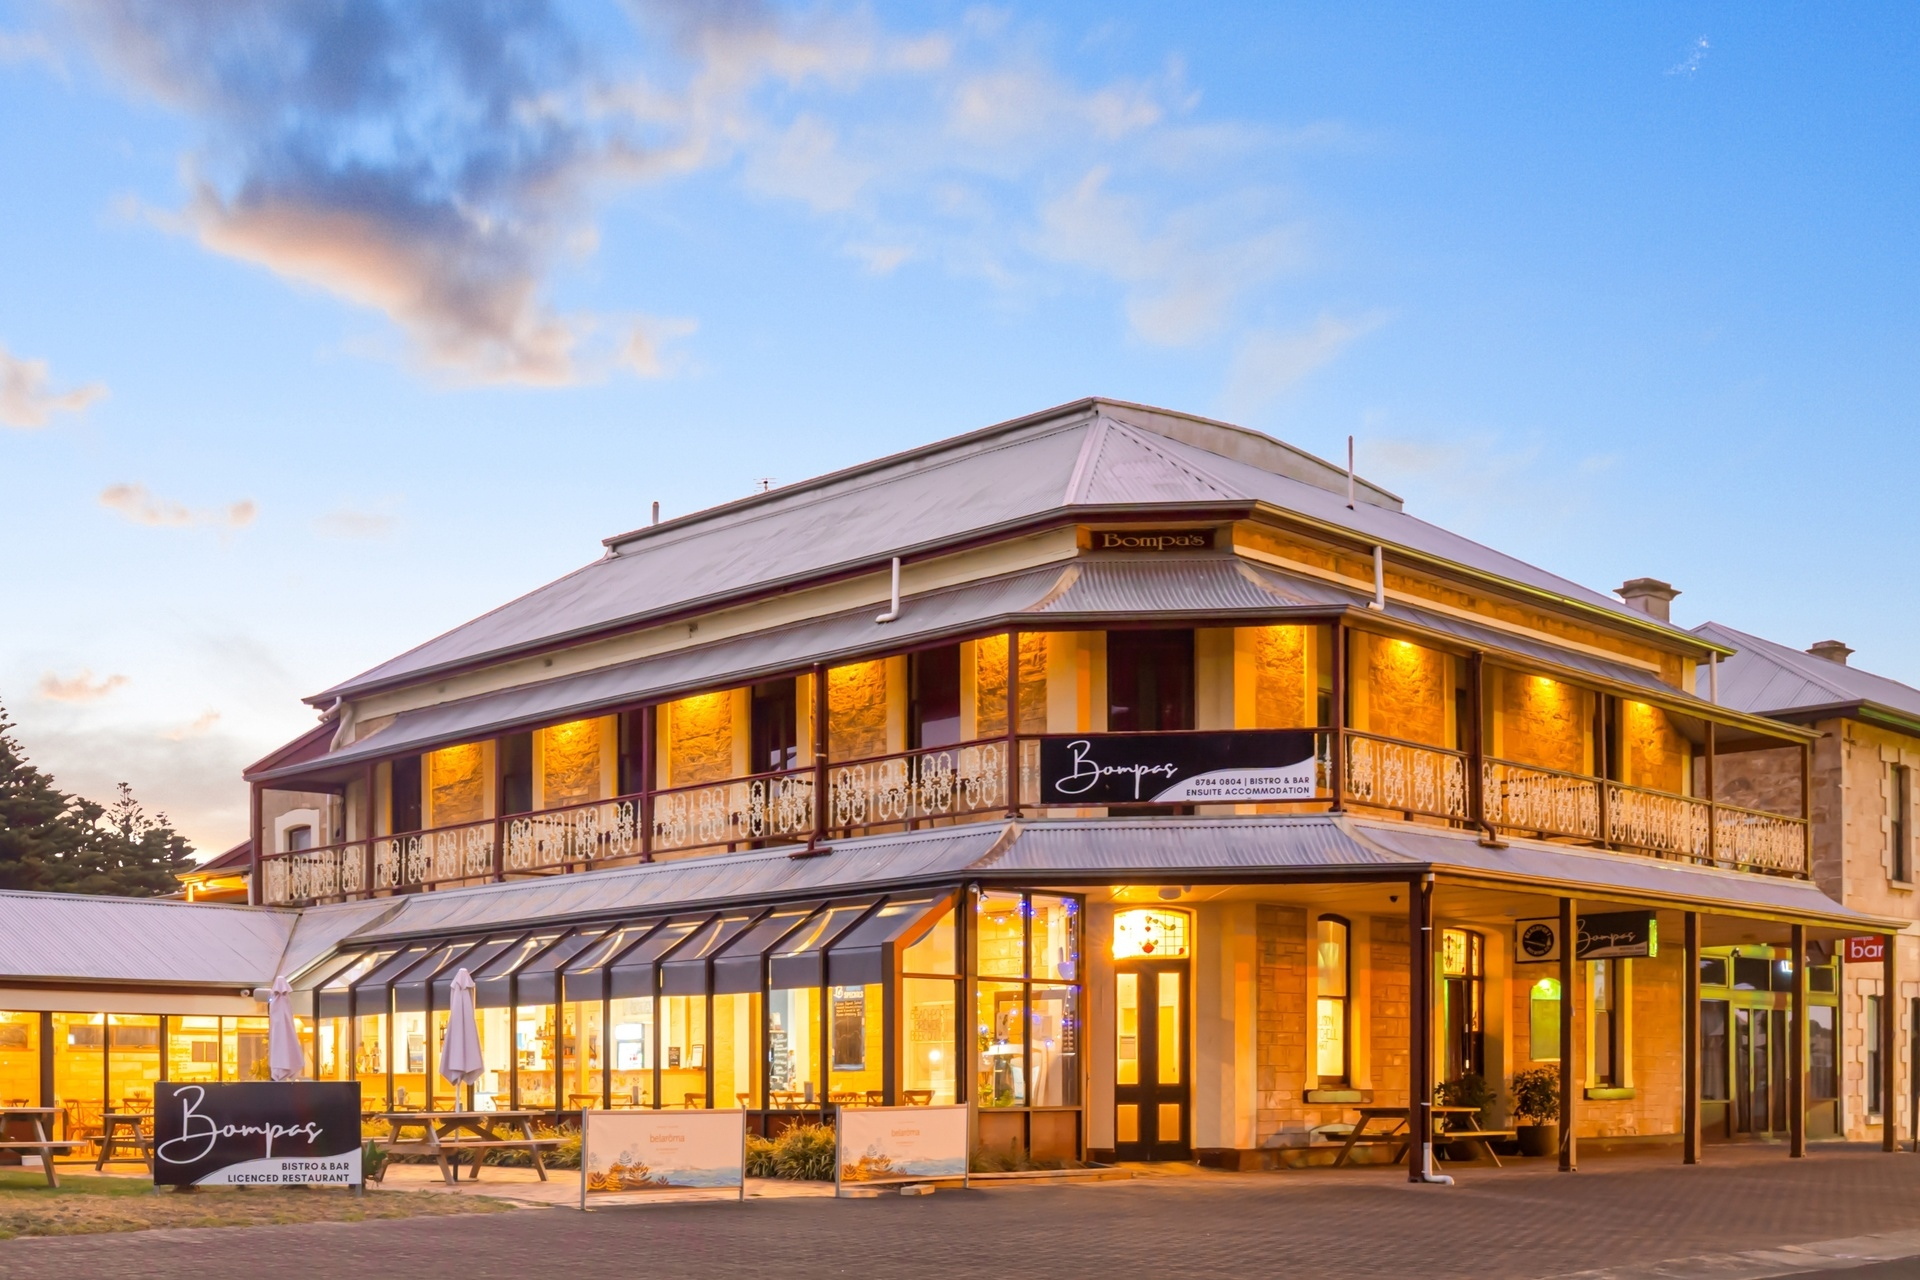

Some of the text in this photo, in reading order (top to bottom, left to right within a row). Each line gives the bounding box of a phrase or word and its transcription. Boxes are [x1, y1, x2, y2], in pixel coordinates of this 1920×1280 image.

[1102, 533, 1205, 550] Bompa's
[1055, 740, 1178, 799] Bompas
[1219, 778, 1242, 786] 0804
[1249, 777, 1281, 785] BISTRO
[1186, 786, 1310, 796] ENSUITE ACCOMMODATION
[1851, 941, 1883, 958] bar
[157, 1085, 323, 1164] Bompas
[282, 1162, 350, 1171] BISTRO & BAR
[227, 1174, 350, 1183] LICENCED RESTAURANT
